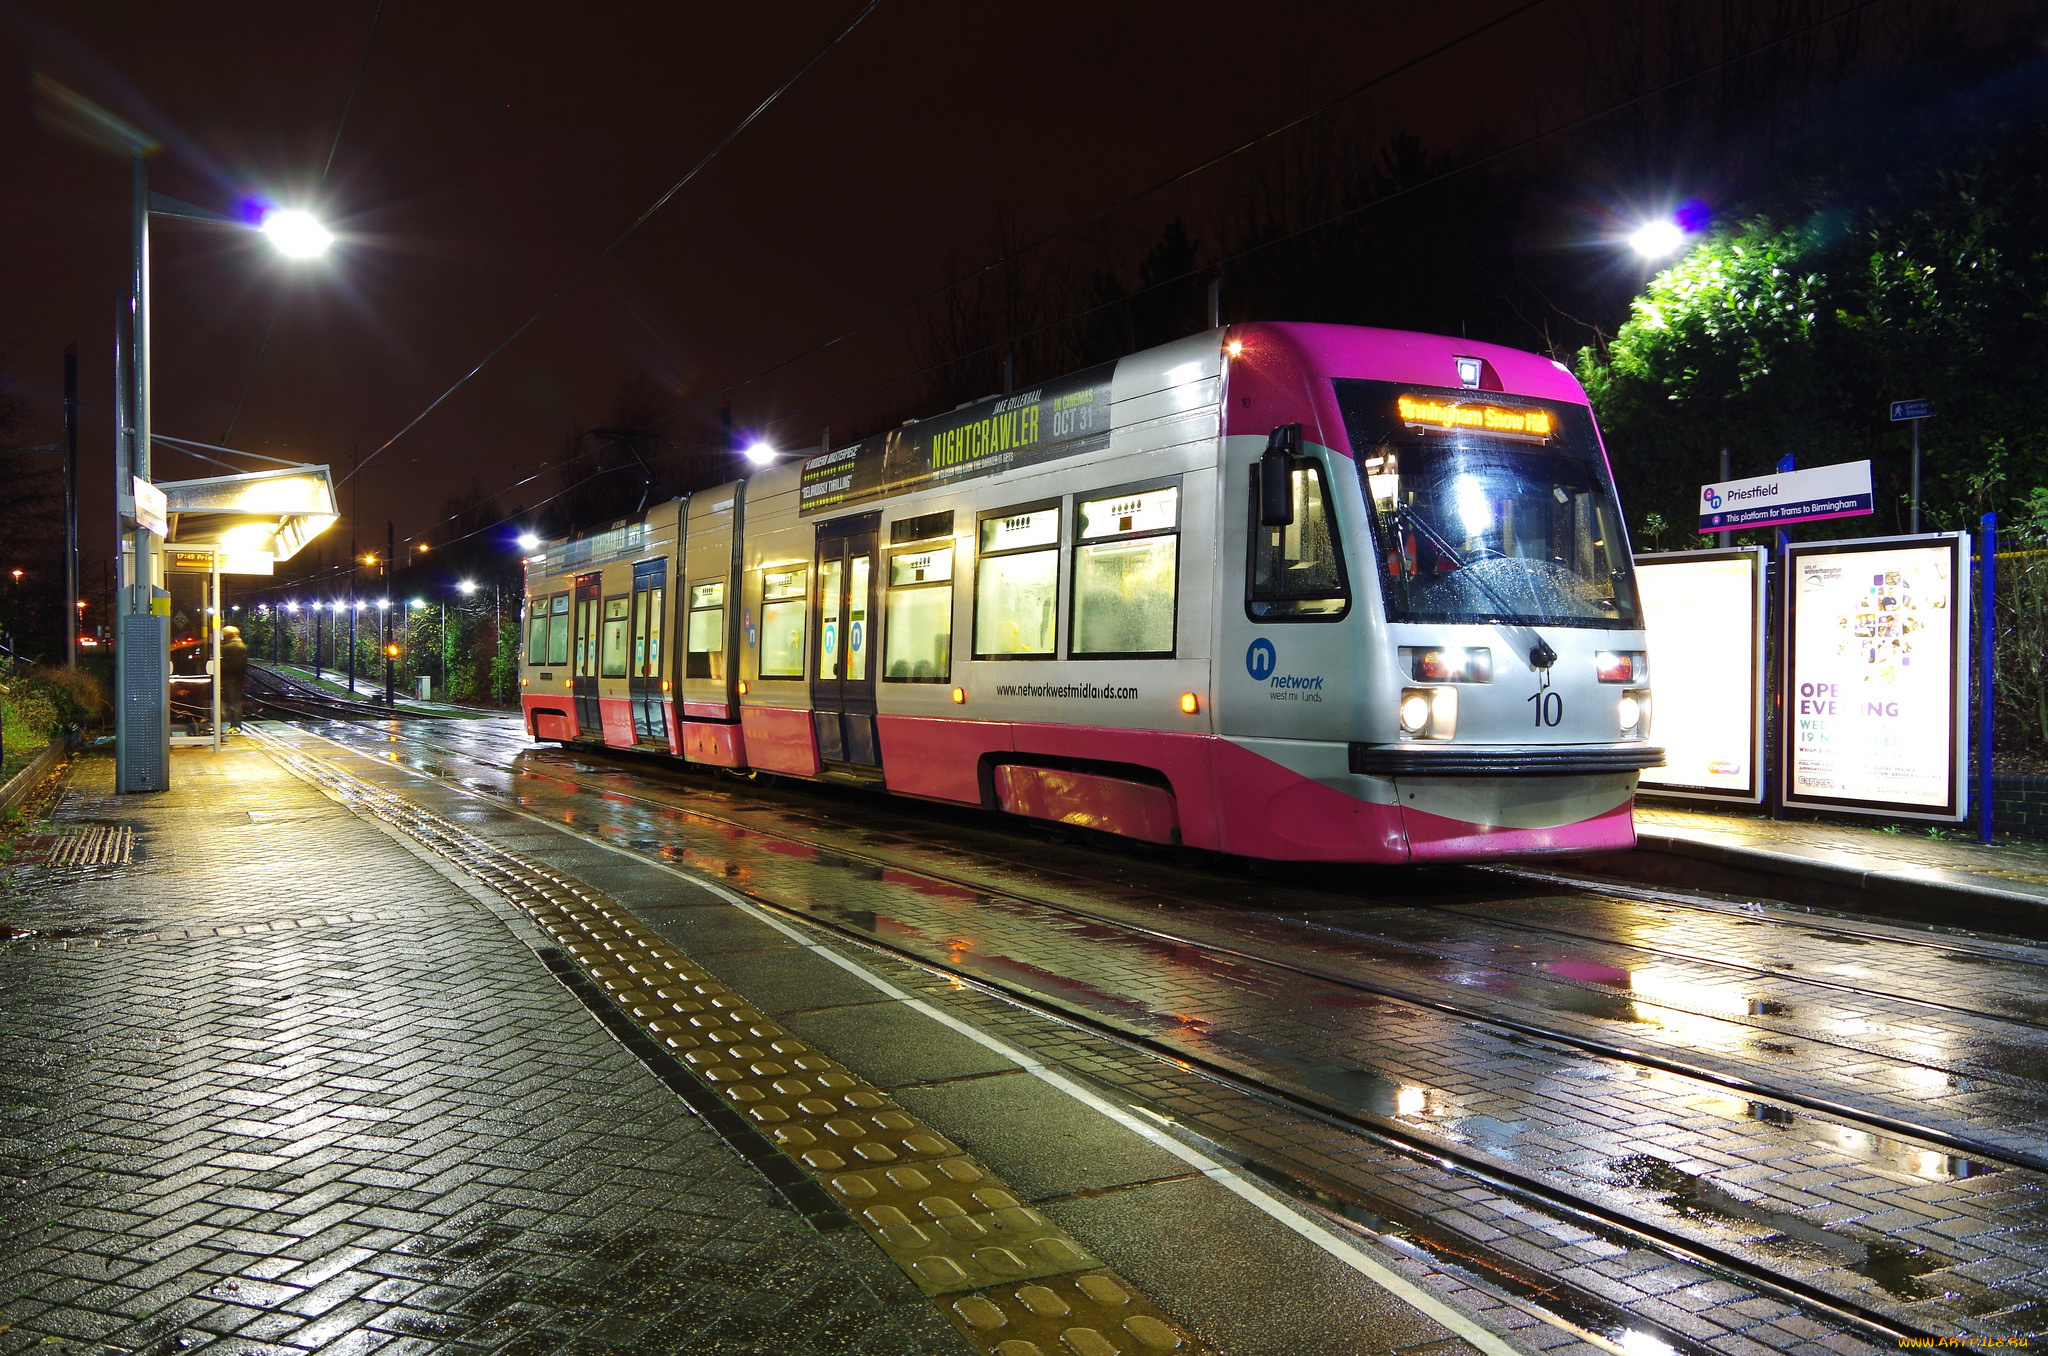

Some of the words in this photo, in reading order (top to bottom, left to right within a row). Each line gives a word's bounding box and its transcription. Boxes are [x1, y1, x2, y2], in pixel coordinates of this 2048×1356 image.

[992, 399, 1008, 415] JAKE
[1053, 397, 1062, 412] IN
[1063, 388, 1094, 409] CINEMAS
[1241, 397, 1252, 409] 10
[1053, 407, 1077, 437] OCT
[1080, 404, 1094, 430] 31
[933, 405, 1039, 469] NIGHTCRAWLER
[1728, 483, 1778, 501] Priestfield
[1726, 514, 1740, 523] This
[1741, 510, 1768, 523] platform
[1770, 508, 1779, 518] for
[1780, 506, 1802, 517] Trams
[1803, 505, 1811, 513] to
[1812, 500, 1858, 514] Birmingham
[1270, 674, 1323, 690] network
[1800, 683, 1840, 698] OPE
[1269, 691, 1288, 701] west
[1527, 692, 1563, 727] 10
